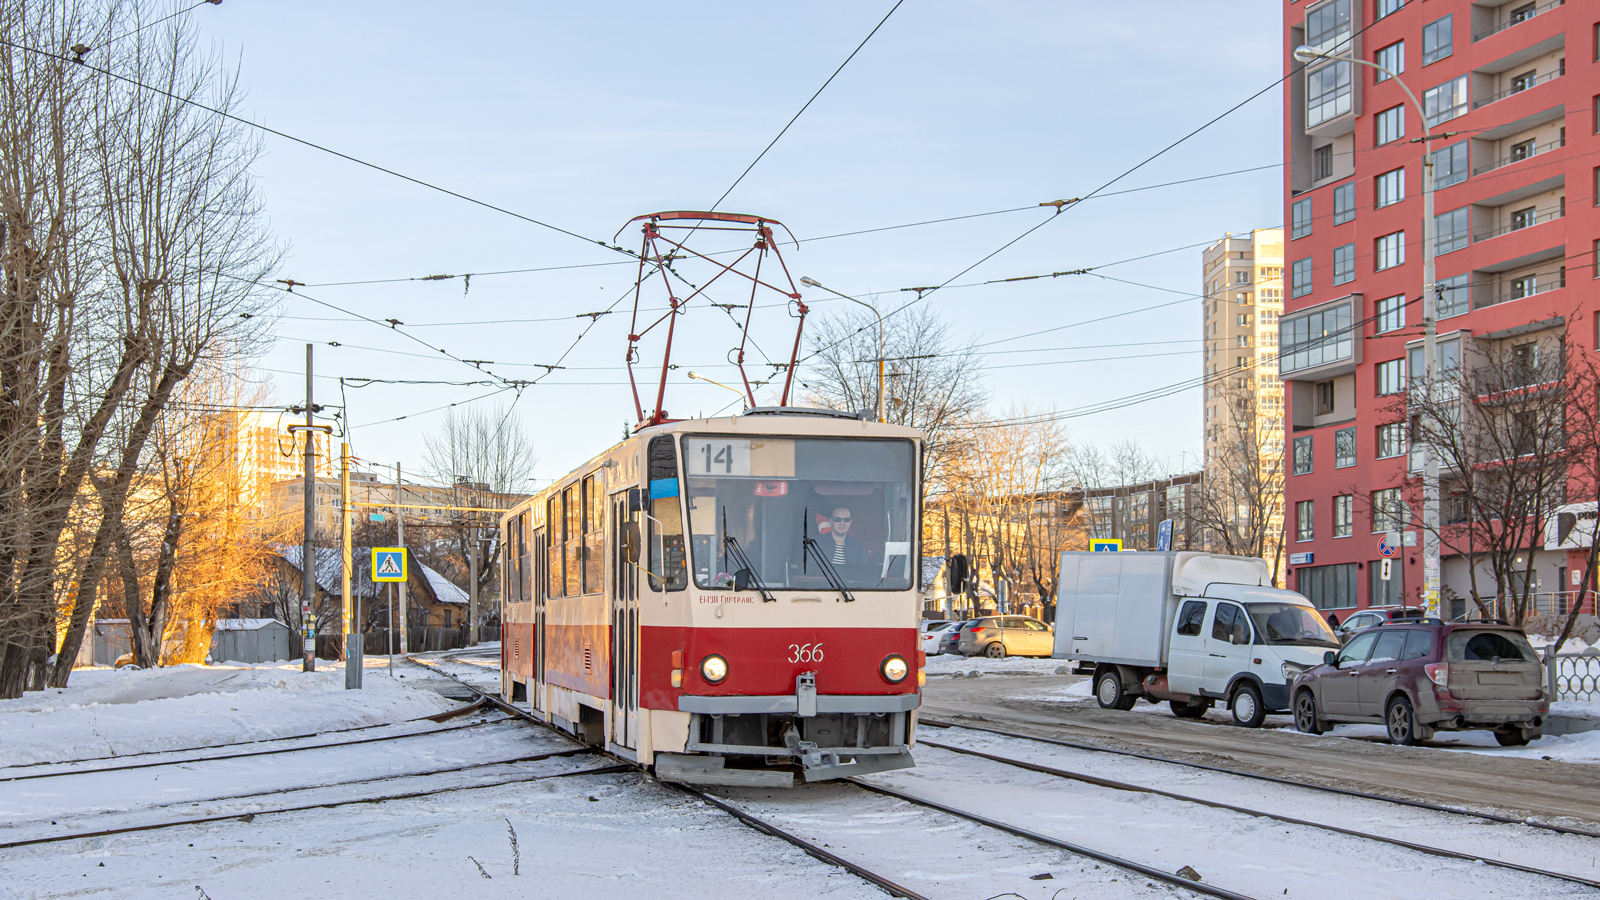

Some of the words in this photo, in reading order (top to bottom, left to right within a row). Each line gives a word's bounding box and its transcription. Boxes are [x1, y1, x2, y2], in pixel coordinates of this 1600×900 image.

[702, 444, 733, 473] 14
[699, 595, 718, 604] ЕМУП
[788, 643, 824, 663] 366
